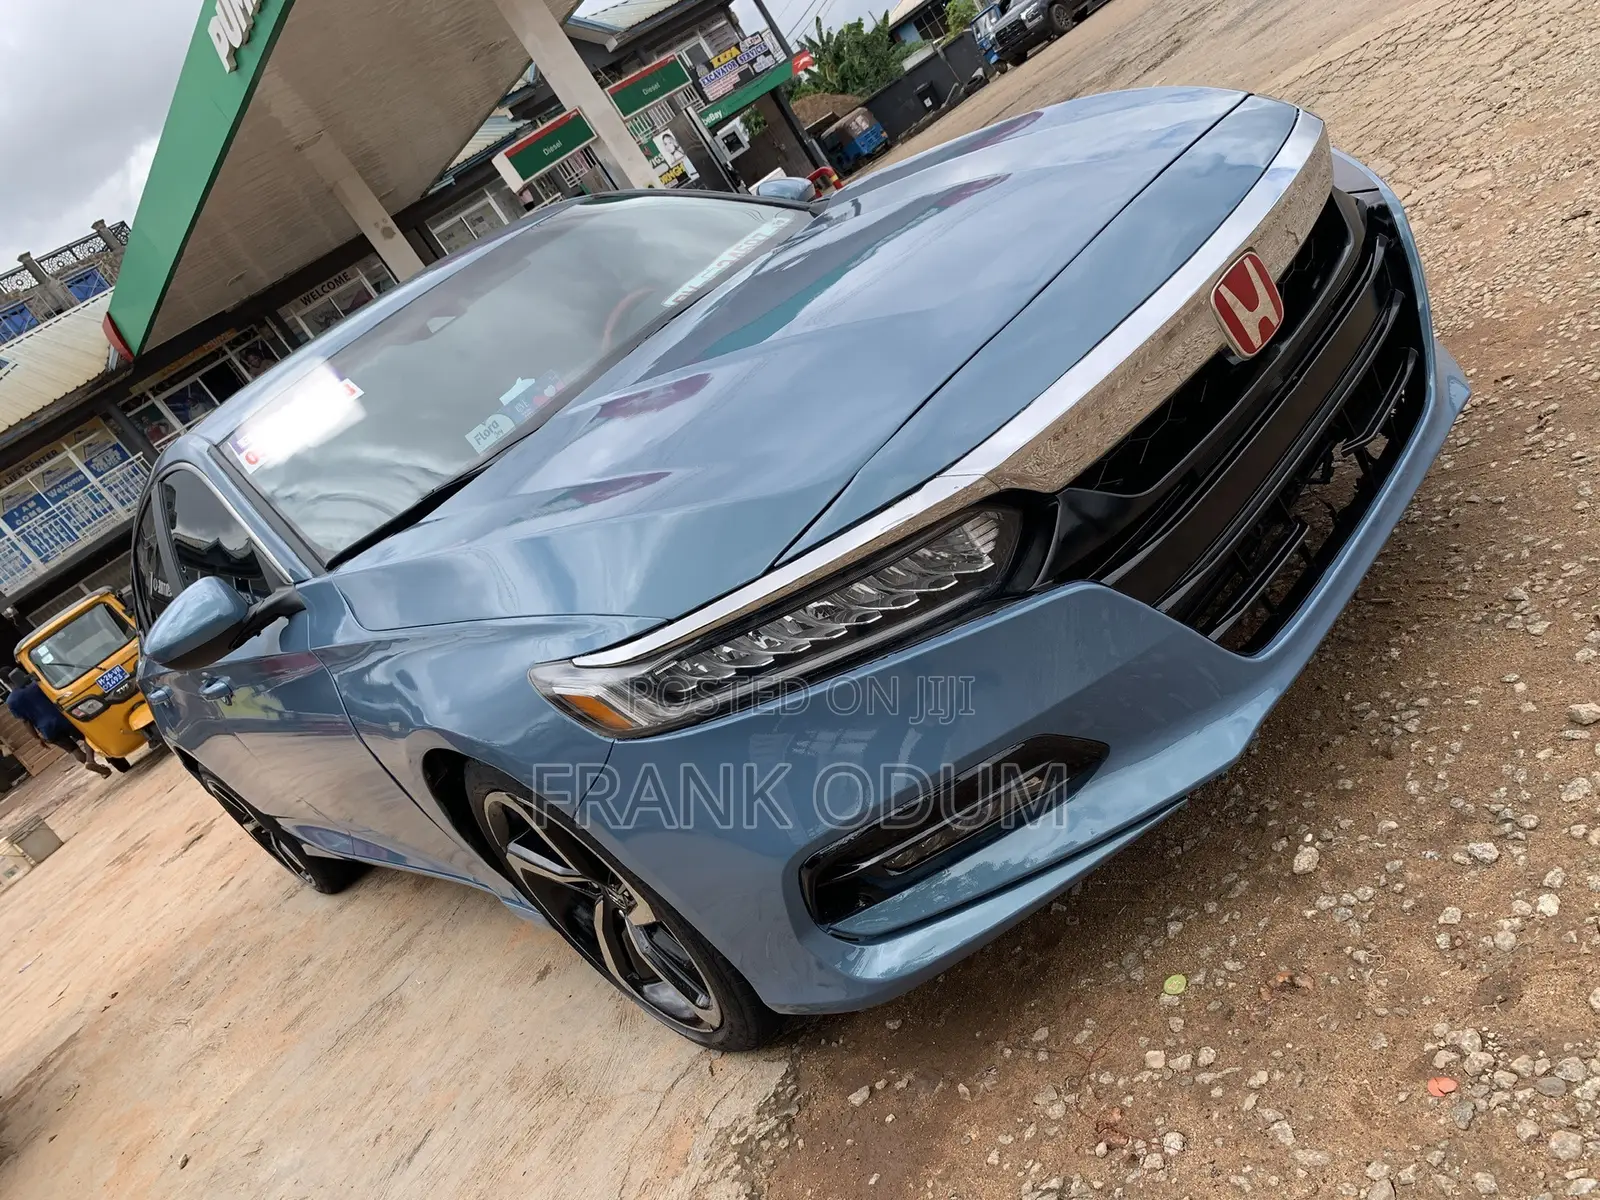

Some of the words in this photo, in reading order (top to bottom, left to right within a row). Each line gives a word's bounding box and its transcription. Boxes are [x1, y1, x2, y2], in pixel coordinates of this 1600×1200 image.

[208, 0, 258, 74] PUM
[701, 60, 738, 86] EXCAVATOR
[738, 42, 768, 63] SERVICES
[642, 82, 661, 96] Diesel
[542, 139, 563, 156] Diesel
[300, 271, 351, 306] WELCOME
[473, 419, 500, 446] Flora
[24, 448, 58, 473] CENTER
[46, 473, 86, 498] Welcome
[15, 506, 44, 526] COME
[22, 500, 37, 514] AM
